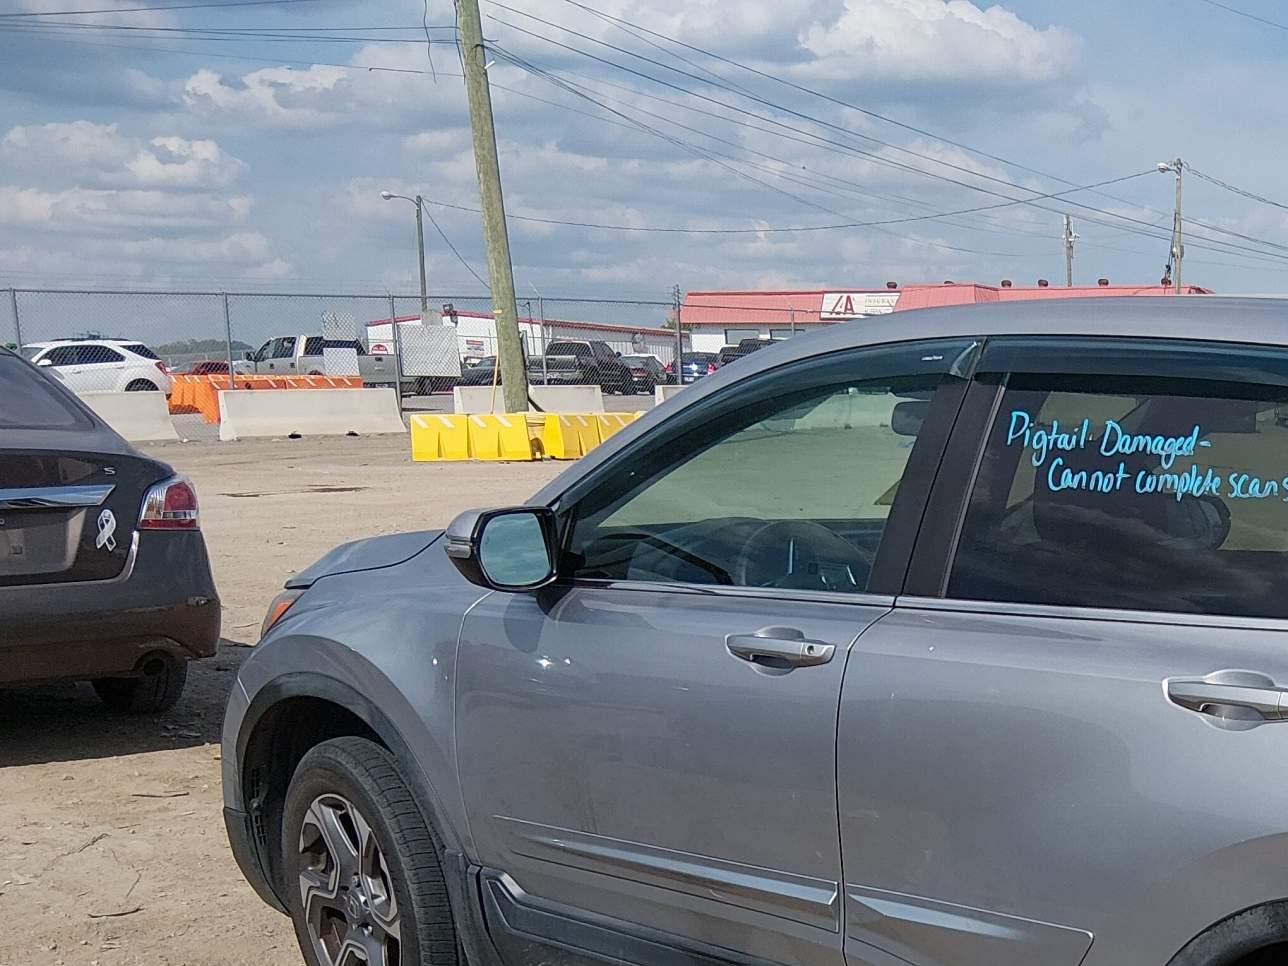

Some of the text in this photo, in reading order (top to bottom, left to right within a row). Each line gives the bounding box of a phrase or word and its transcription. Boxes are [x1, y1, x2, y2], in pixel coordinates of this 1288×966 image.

[1007, 411, 1089, 467] Pigtail
[1048, 458, 1132, 492] Cannot
[1136, 464, 1220, 502] complete
